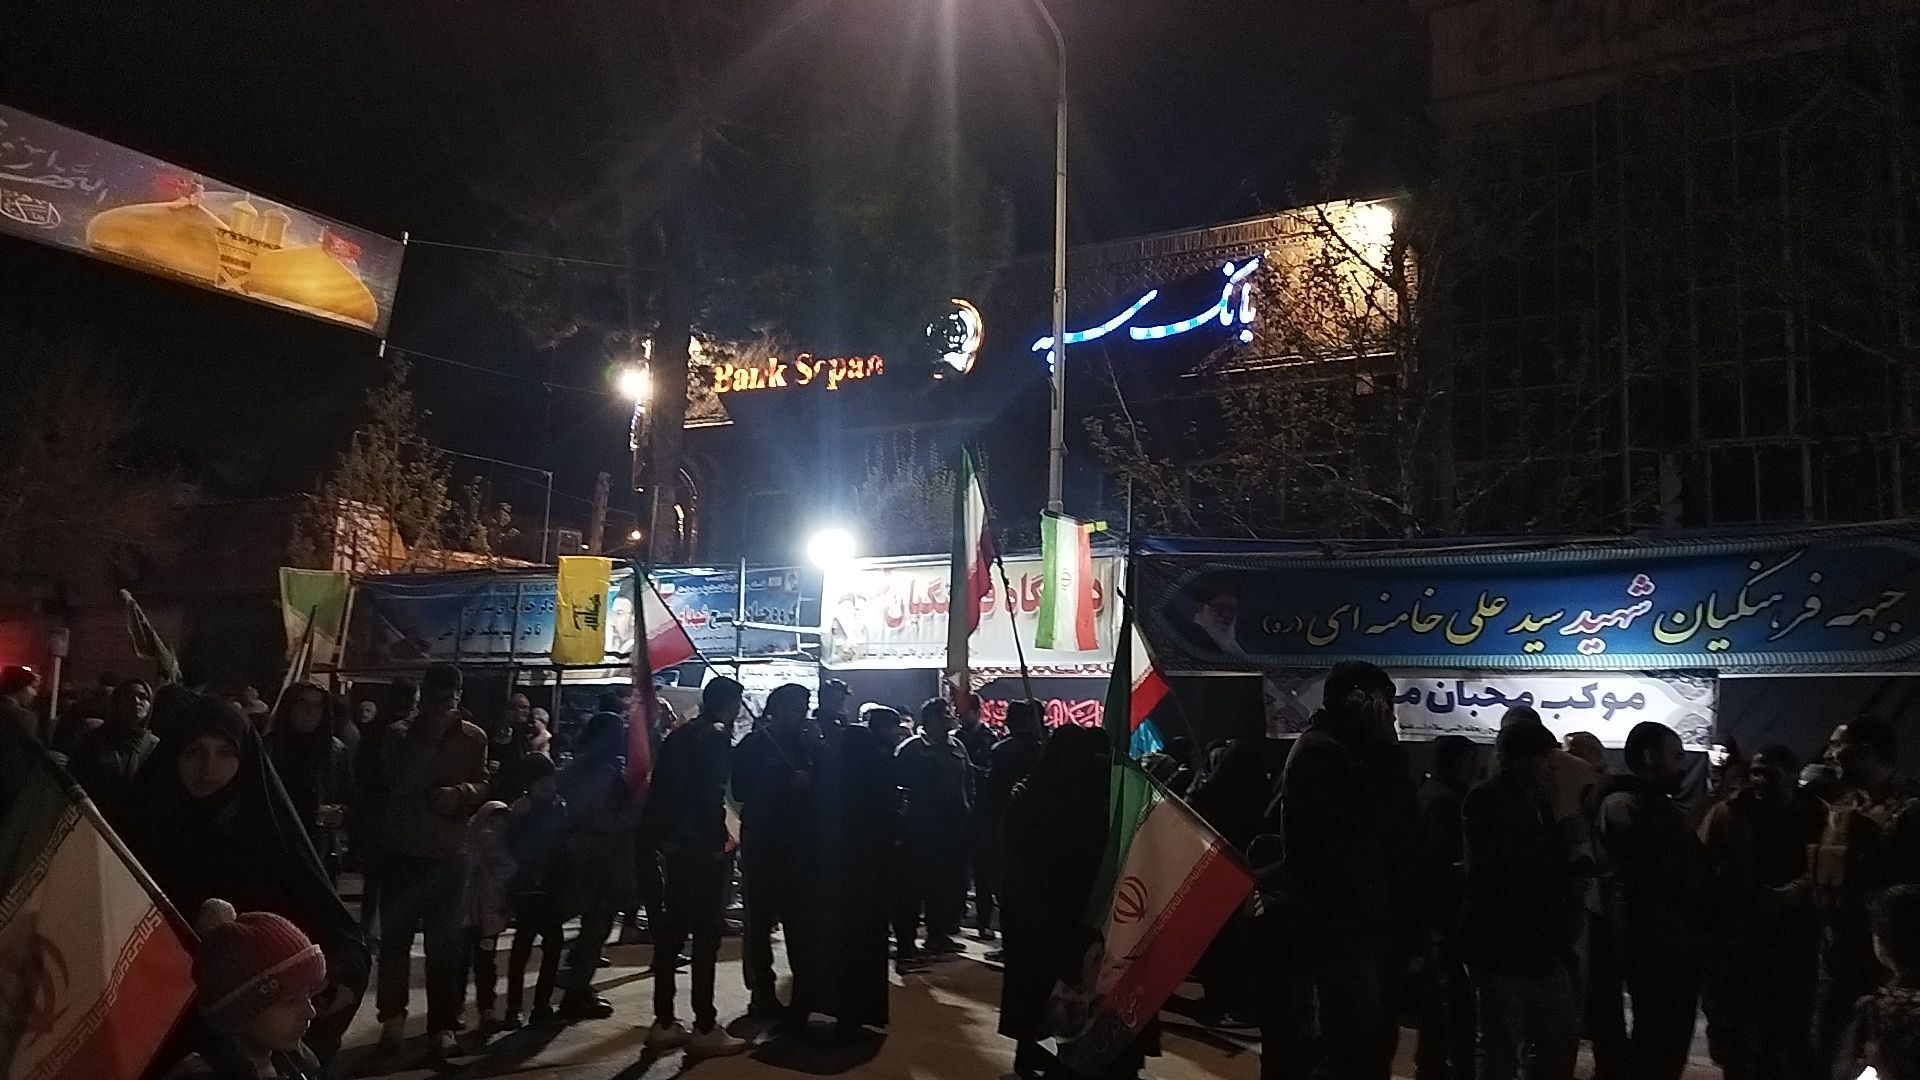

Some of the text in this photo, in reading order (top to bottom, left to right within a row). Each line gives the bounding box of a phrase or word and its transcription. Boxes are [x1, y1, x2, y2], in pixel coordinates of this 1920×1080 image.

[1130, 256, 1260, 343] بانک
[1445, 591, 1508, 645] علی
[1559, 573, 1655, 655] شهید
[1653, 549, 1823, 652] فرهنگیان
[1825, 589, 1908, 643] جبهه
[1506, 609, 1565, 653] سید
[1426, 680, 1535, 717] محبان
[1540, 682, 1646, 721] موکب
